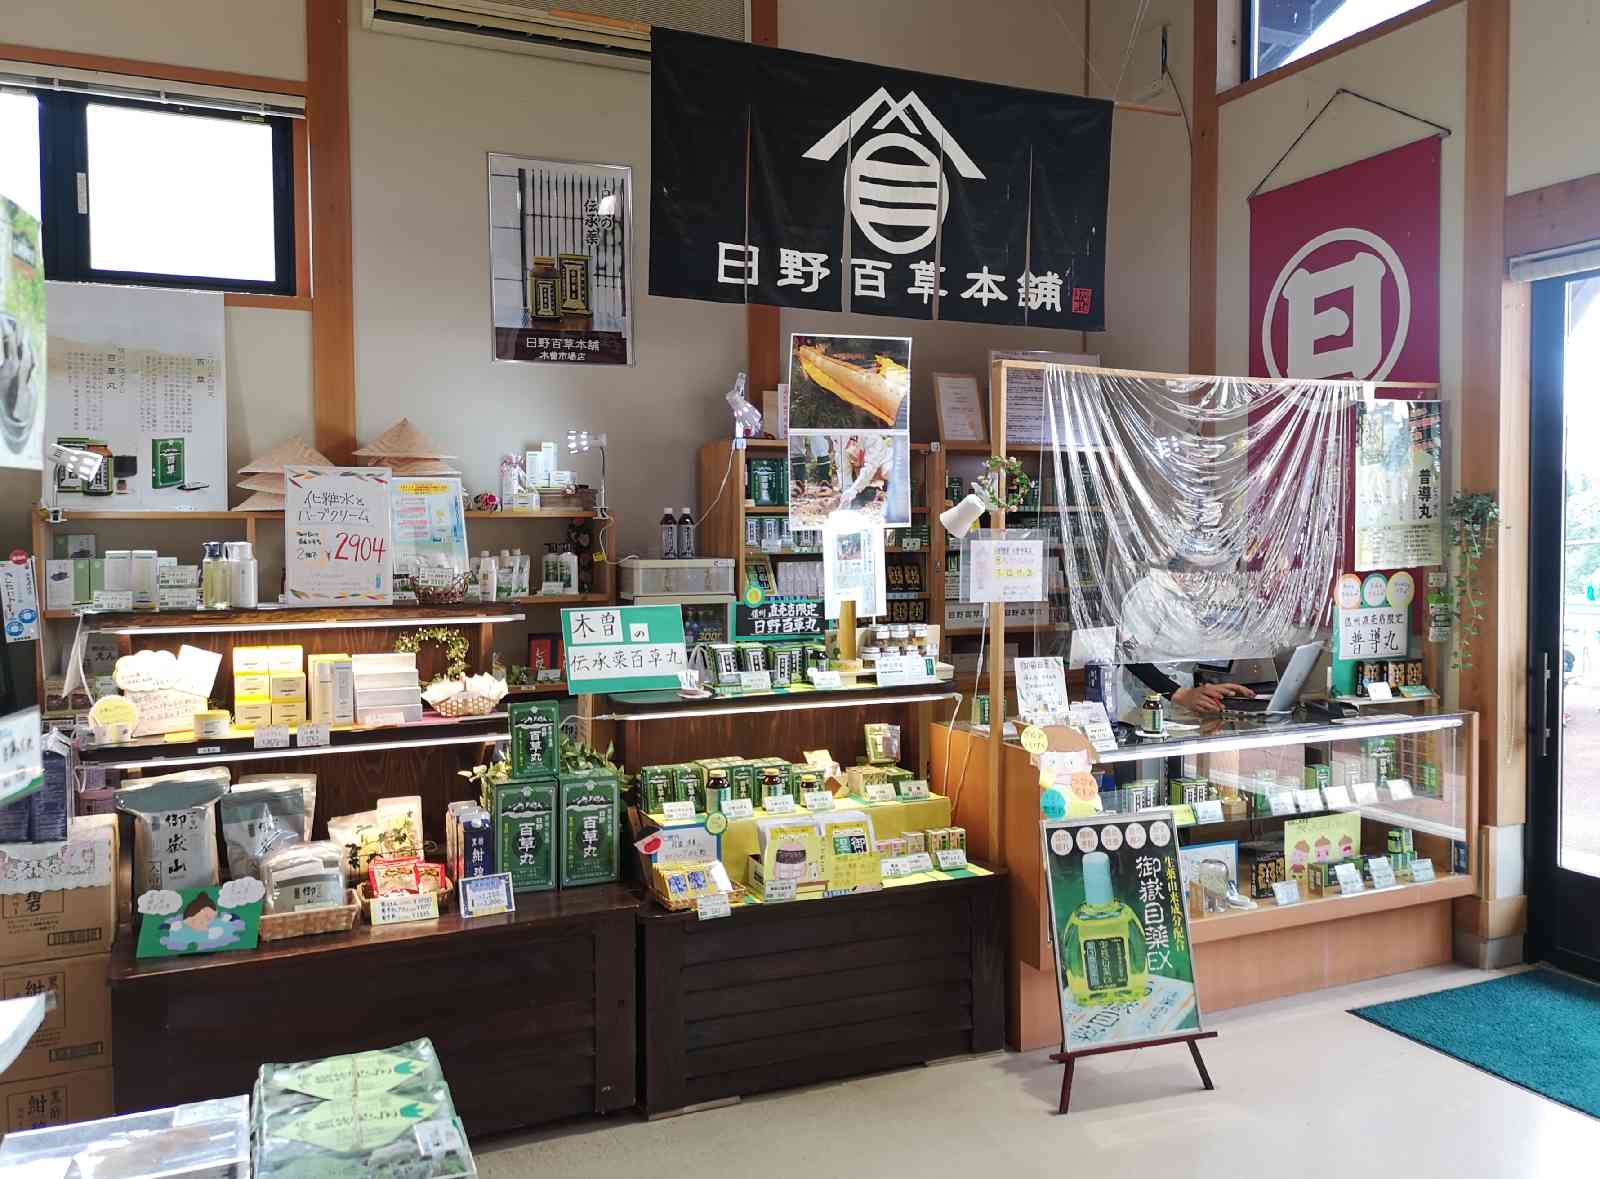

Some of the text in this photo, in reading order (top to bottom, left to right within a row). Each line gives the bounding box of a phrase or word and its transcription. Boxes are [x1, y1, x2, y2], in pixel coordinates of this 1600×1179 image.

[716, 241, 1063, 313] 日野百草本舗
[526, 337, 600, 351] 日野百草本舗
[1418, 468, 1432, 519] 普導丸
[335, 532, 387, 563] 2904
[754, 617, 820, 633] 日野百草丸
[571, 648, 683, 673] 伝承薬百草丸
[529, 730, 543, 762] 百草丸
[165, 814, 187, 874] 御嶽山
[518, 822, 536, 865] 百草丸
[582, 815, 600, 858] 百草丸
[1135, 855, 1173, 971] 御嶽目薬EX
